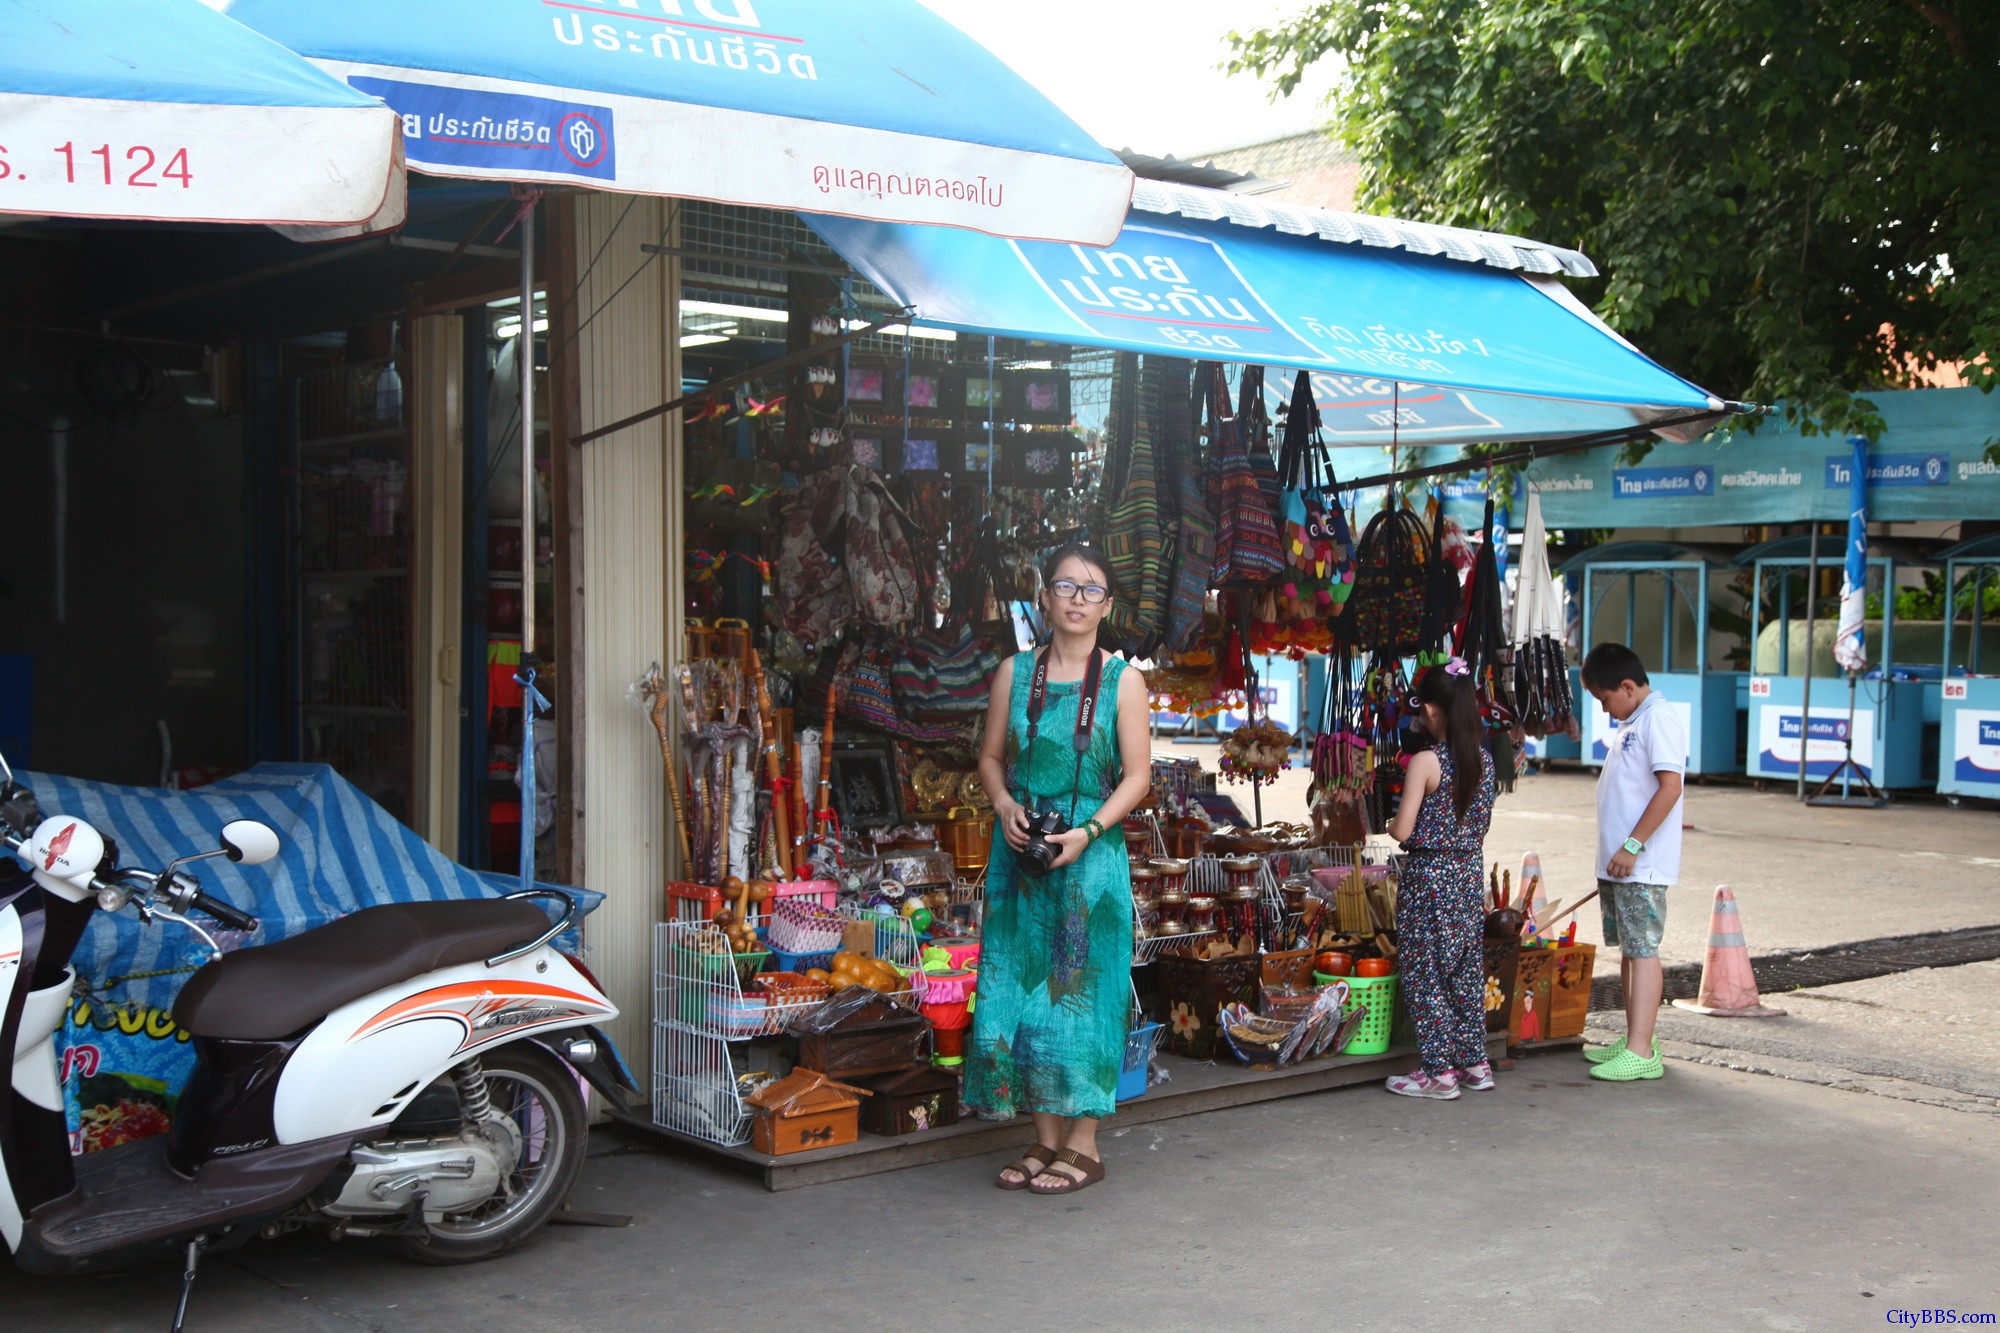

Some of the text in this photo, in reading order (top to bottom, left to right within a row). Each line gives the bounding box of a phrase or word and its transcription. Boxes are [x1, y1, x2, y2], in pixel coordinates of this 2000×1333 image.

[552, 13, 818, 81] ประกันชีวิต
[428, 113, 551, 144] ประกันชีวิต
[54, 141, 193, 189] 1124
[813, 165, 1003, 207] ดูแลคุณตลอดไป
[1059, 275, 1260, 323] ประกัน
[1157, 326, 1244, 349] ชีวิต
[1036, 664, 1045, 686] EOS
[1080, 696, 1092, 726] Canon
